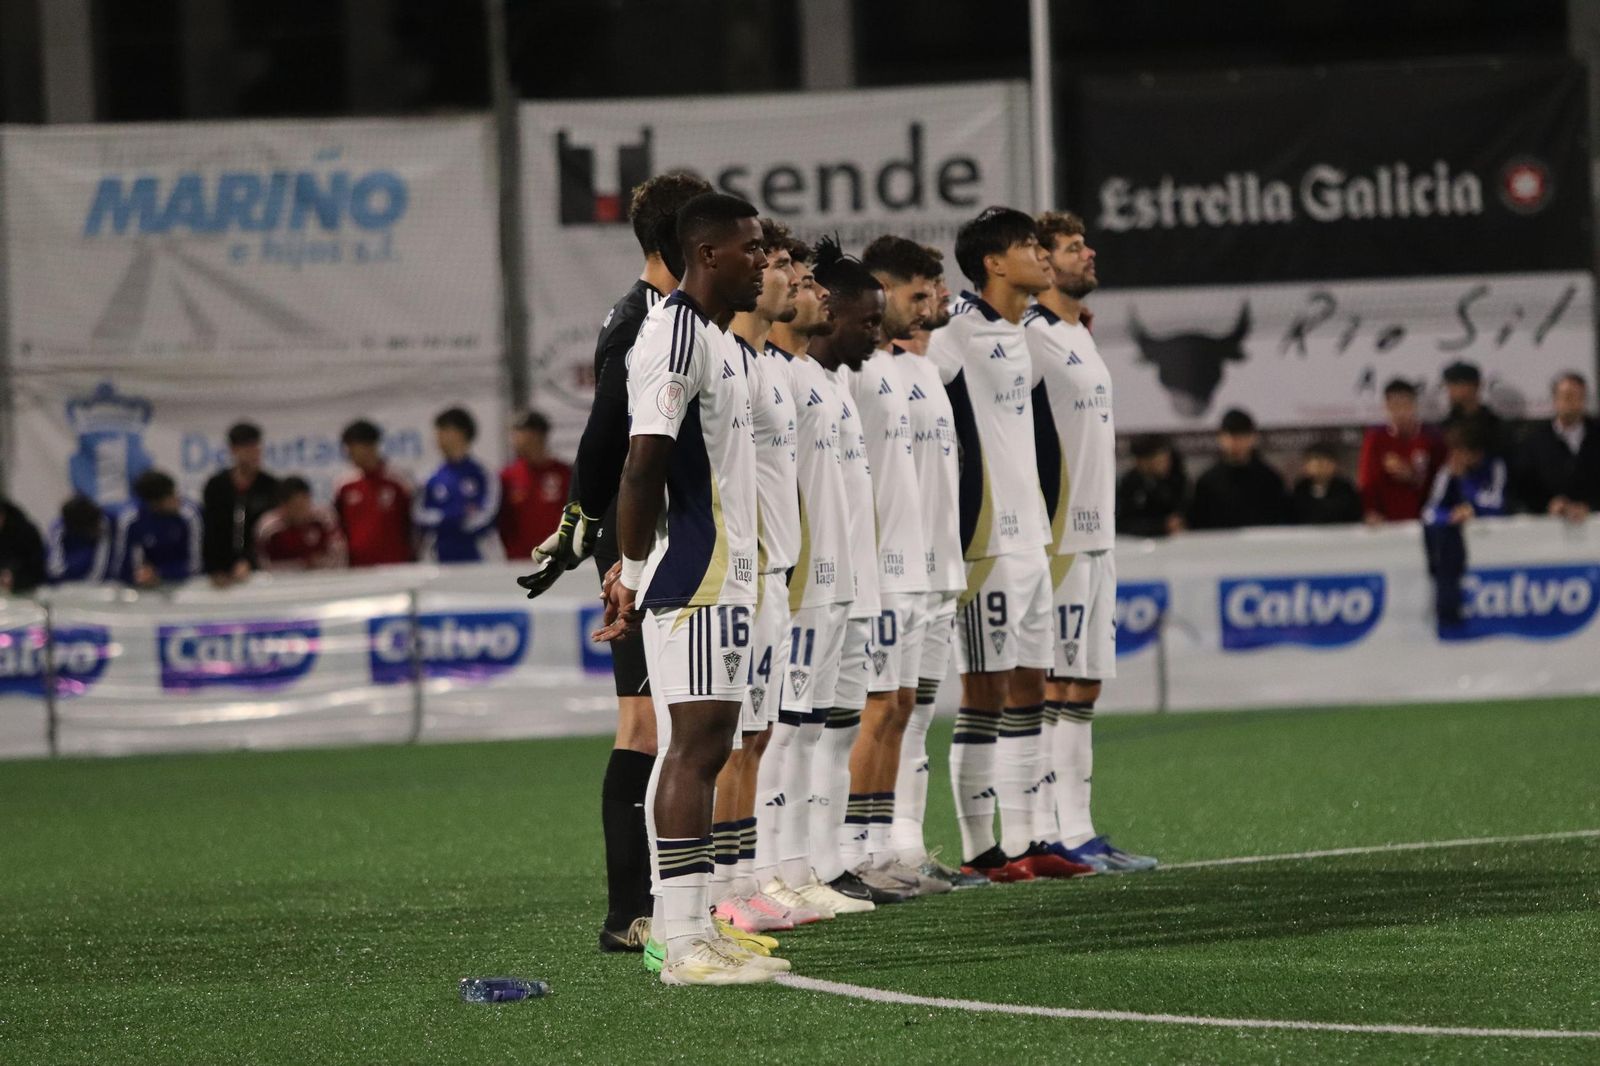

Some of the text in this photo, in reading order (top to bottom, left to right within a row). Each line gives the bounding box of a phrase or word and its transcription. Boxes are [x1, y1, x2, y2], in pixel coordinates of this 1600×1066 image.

[84, 147, 407, 237] MARIÑO
[1098, 160, 1483, 231] Estrella Galicia
[1437, 284, 1576, 352] Sil
[717, 606, 749, 648] 16
[986, 591, 1008, 627] 9
[1057, 604, 1085, 640] 17
[1225, 581, 1375, 630] Calvo
[0, 631, 98, 676] alvo
[166, 630, 310, 672] Calvo
[377, 613, 521, 664] Calvo
[790, 626, 815, 667] 11
